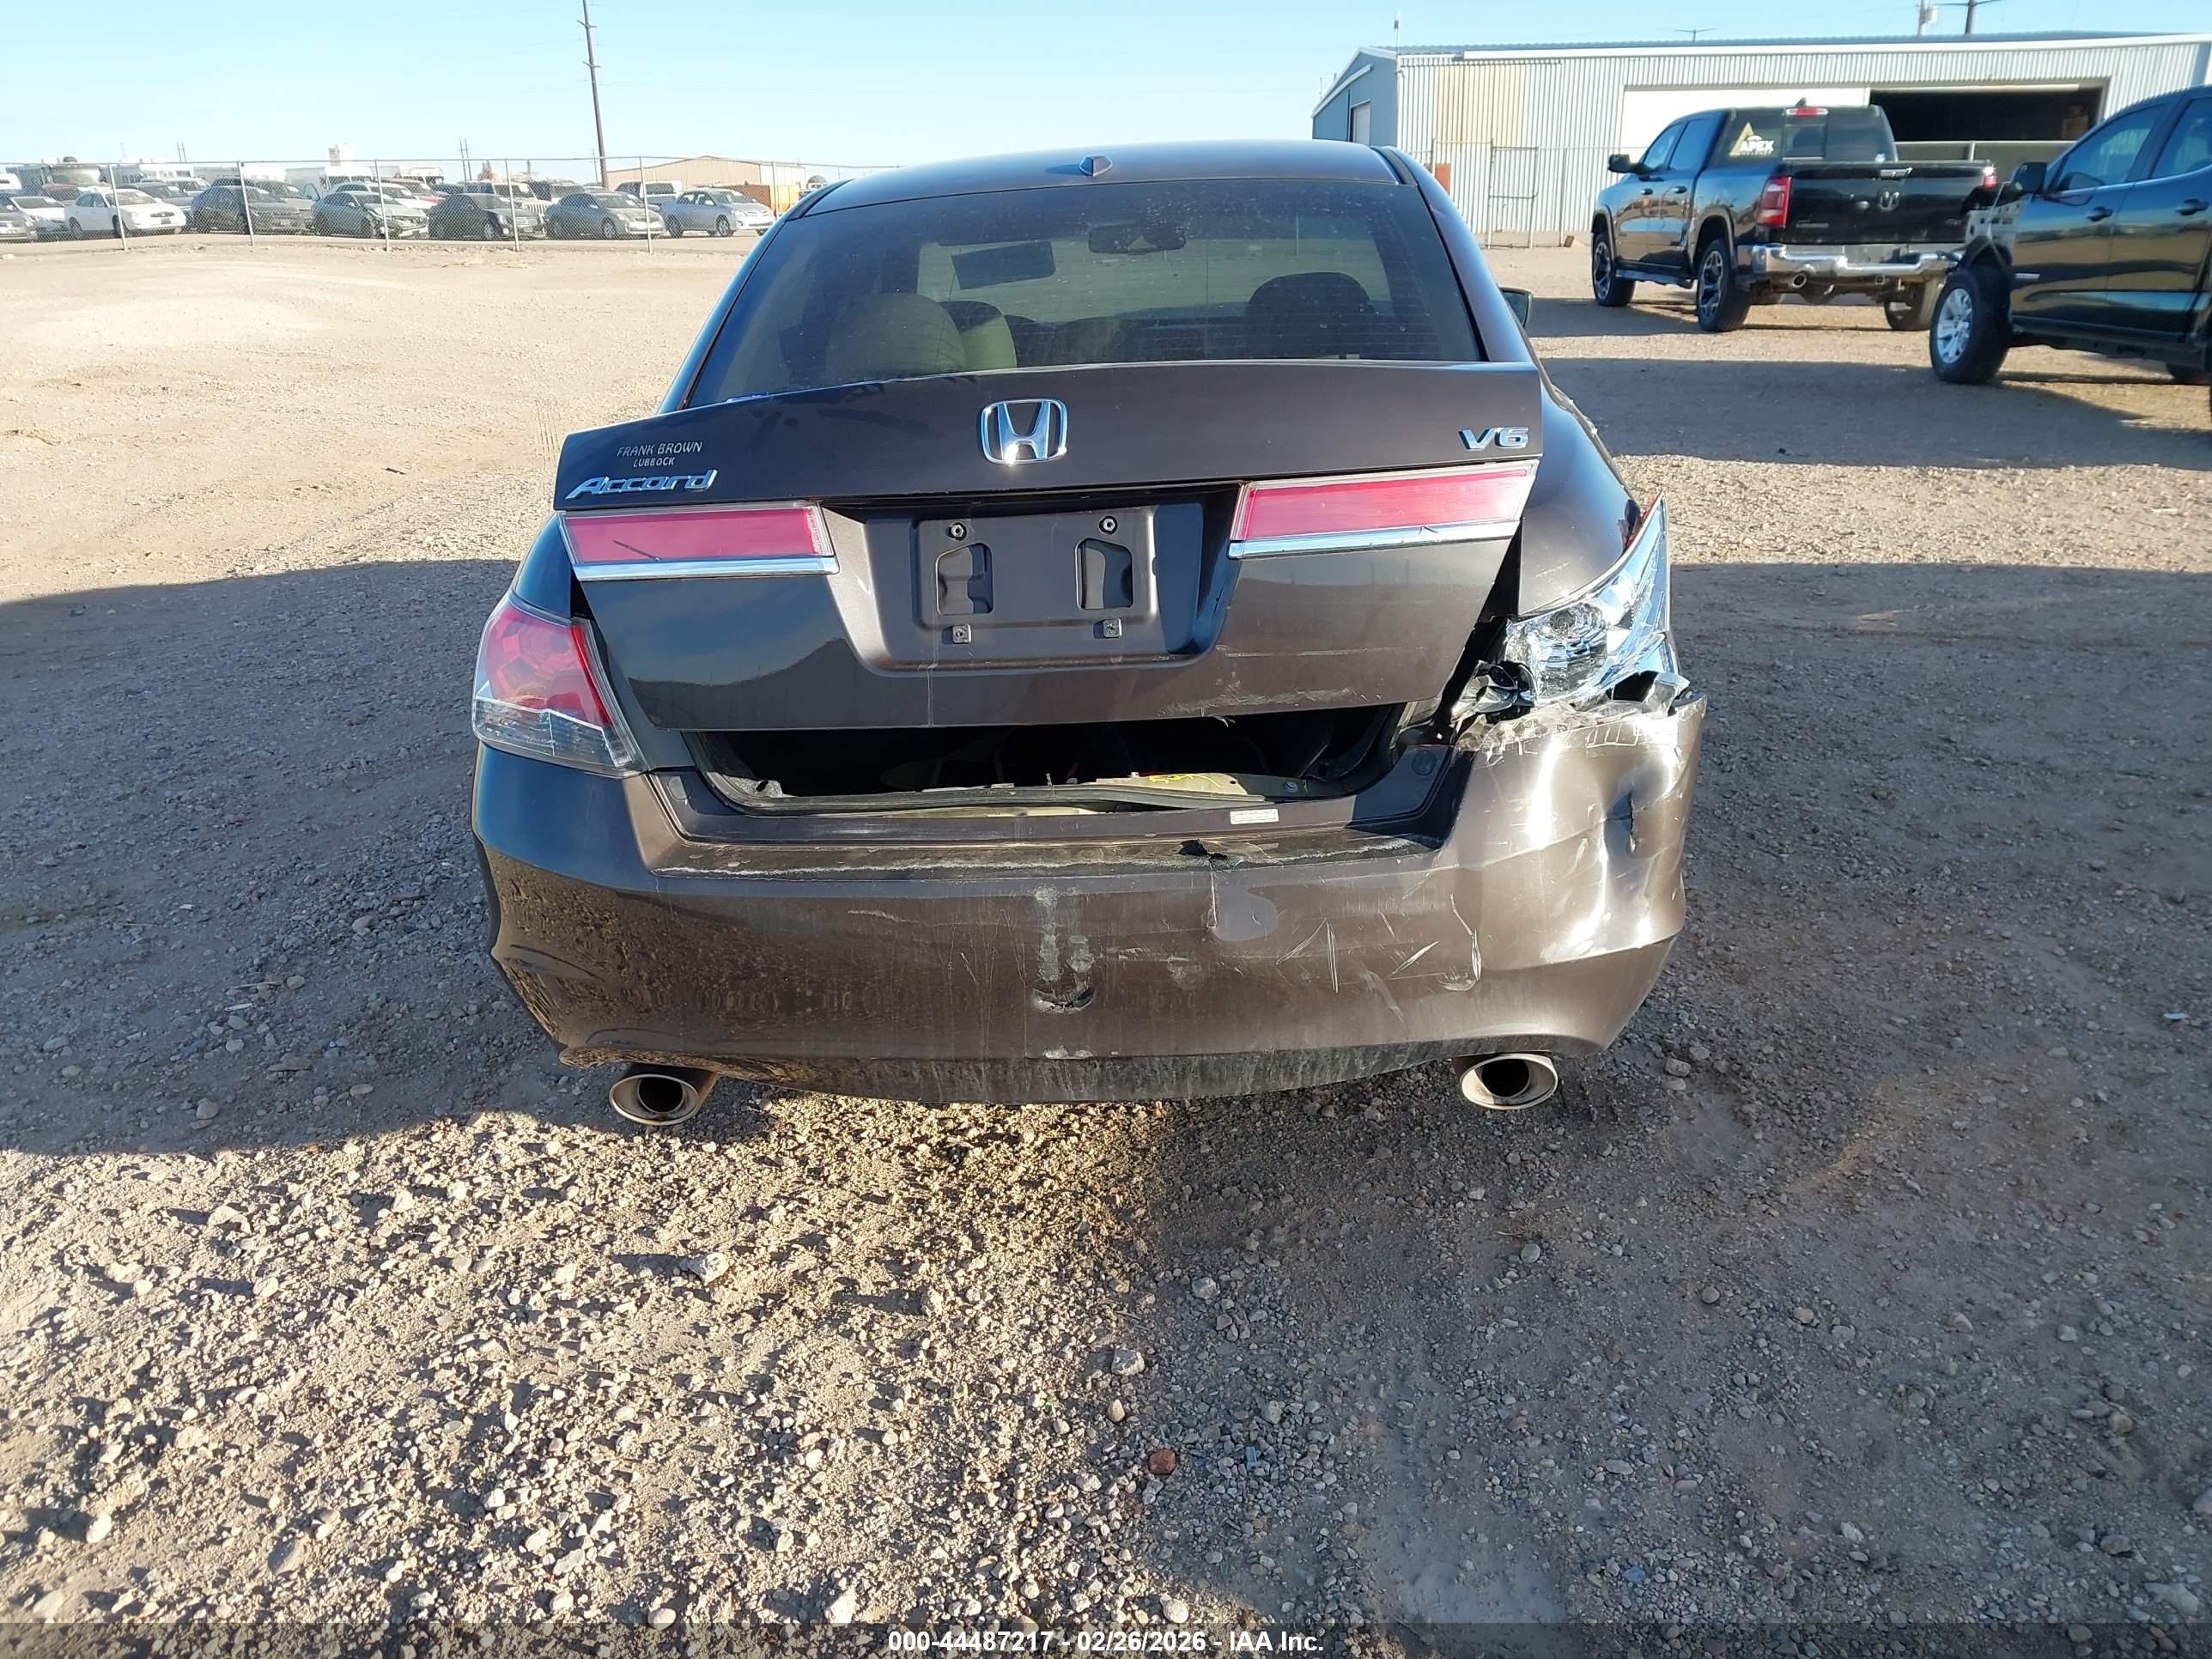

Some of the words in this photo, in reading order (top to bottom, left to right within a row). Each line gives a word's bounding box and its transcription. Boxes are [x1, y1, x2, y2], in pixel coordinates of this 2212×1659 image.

[1740, 140, 1775, 152] APEX
[1458, 427, 1528, 450] V6
[617, 444, 655, 458] FRANK
[657, 441, 703, 455] BROWN
[633, 457, 676, 468] LUBBOCK
[564, 469, 718, 500] Accord
